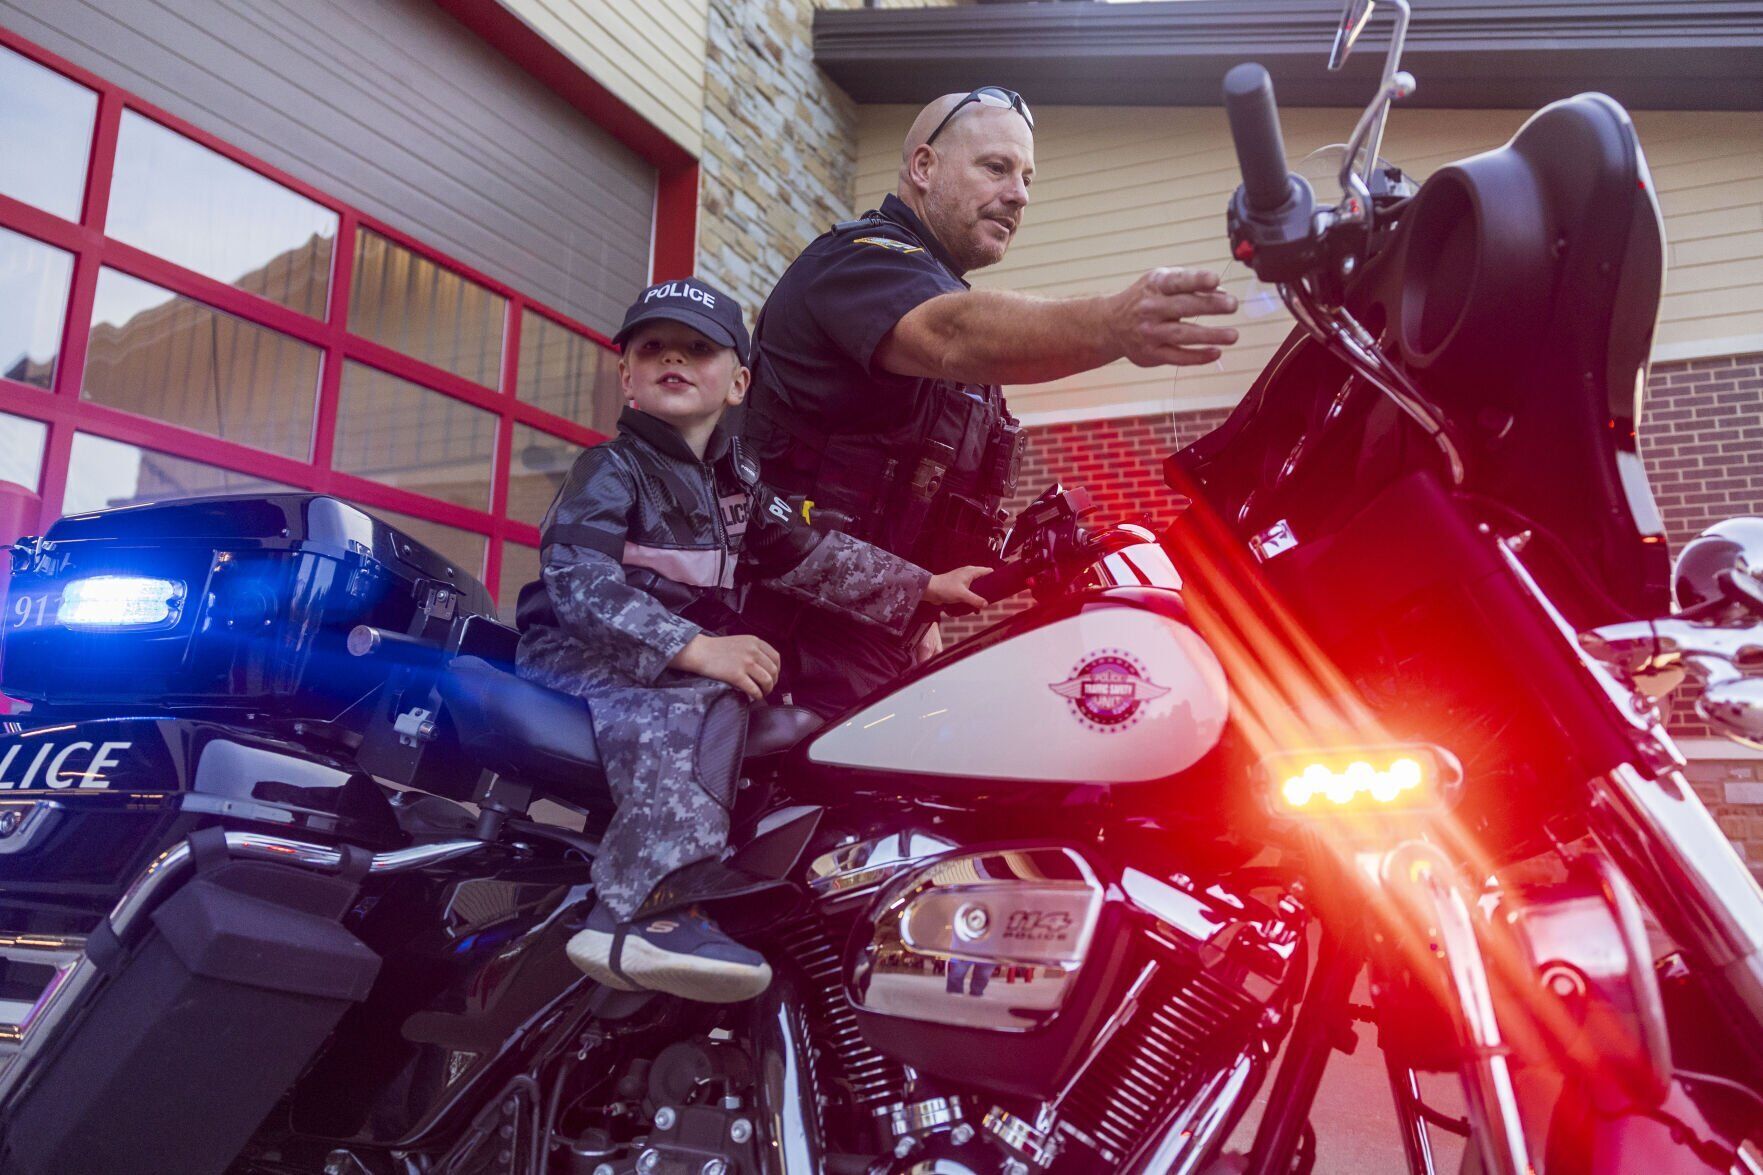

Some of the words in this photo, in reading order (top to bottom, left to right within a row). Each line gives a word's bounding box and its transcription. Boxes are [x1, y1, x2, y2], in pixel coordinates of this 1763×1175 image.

[644, 283, 715, 309] POLICE
[721, 503, 748, 526] LIC
[0, 741, 132, 789] LICE
